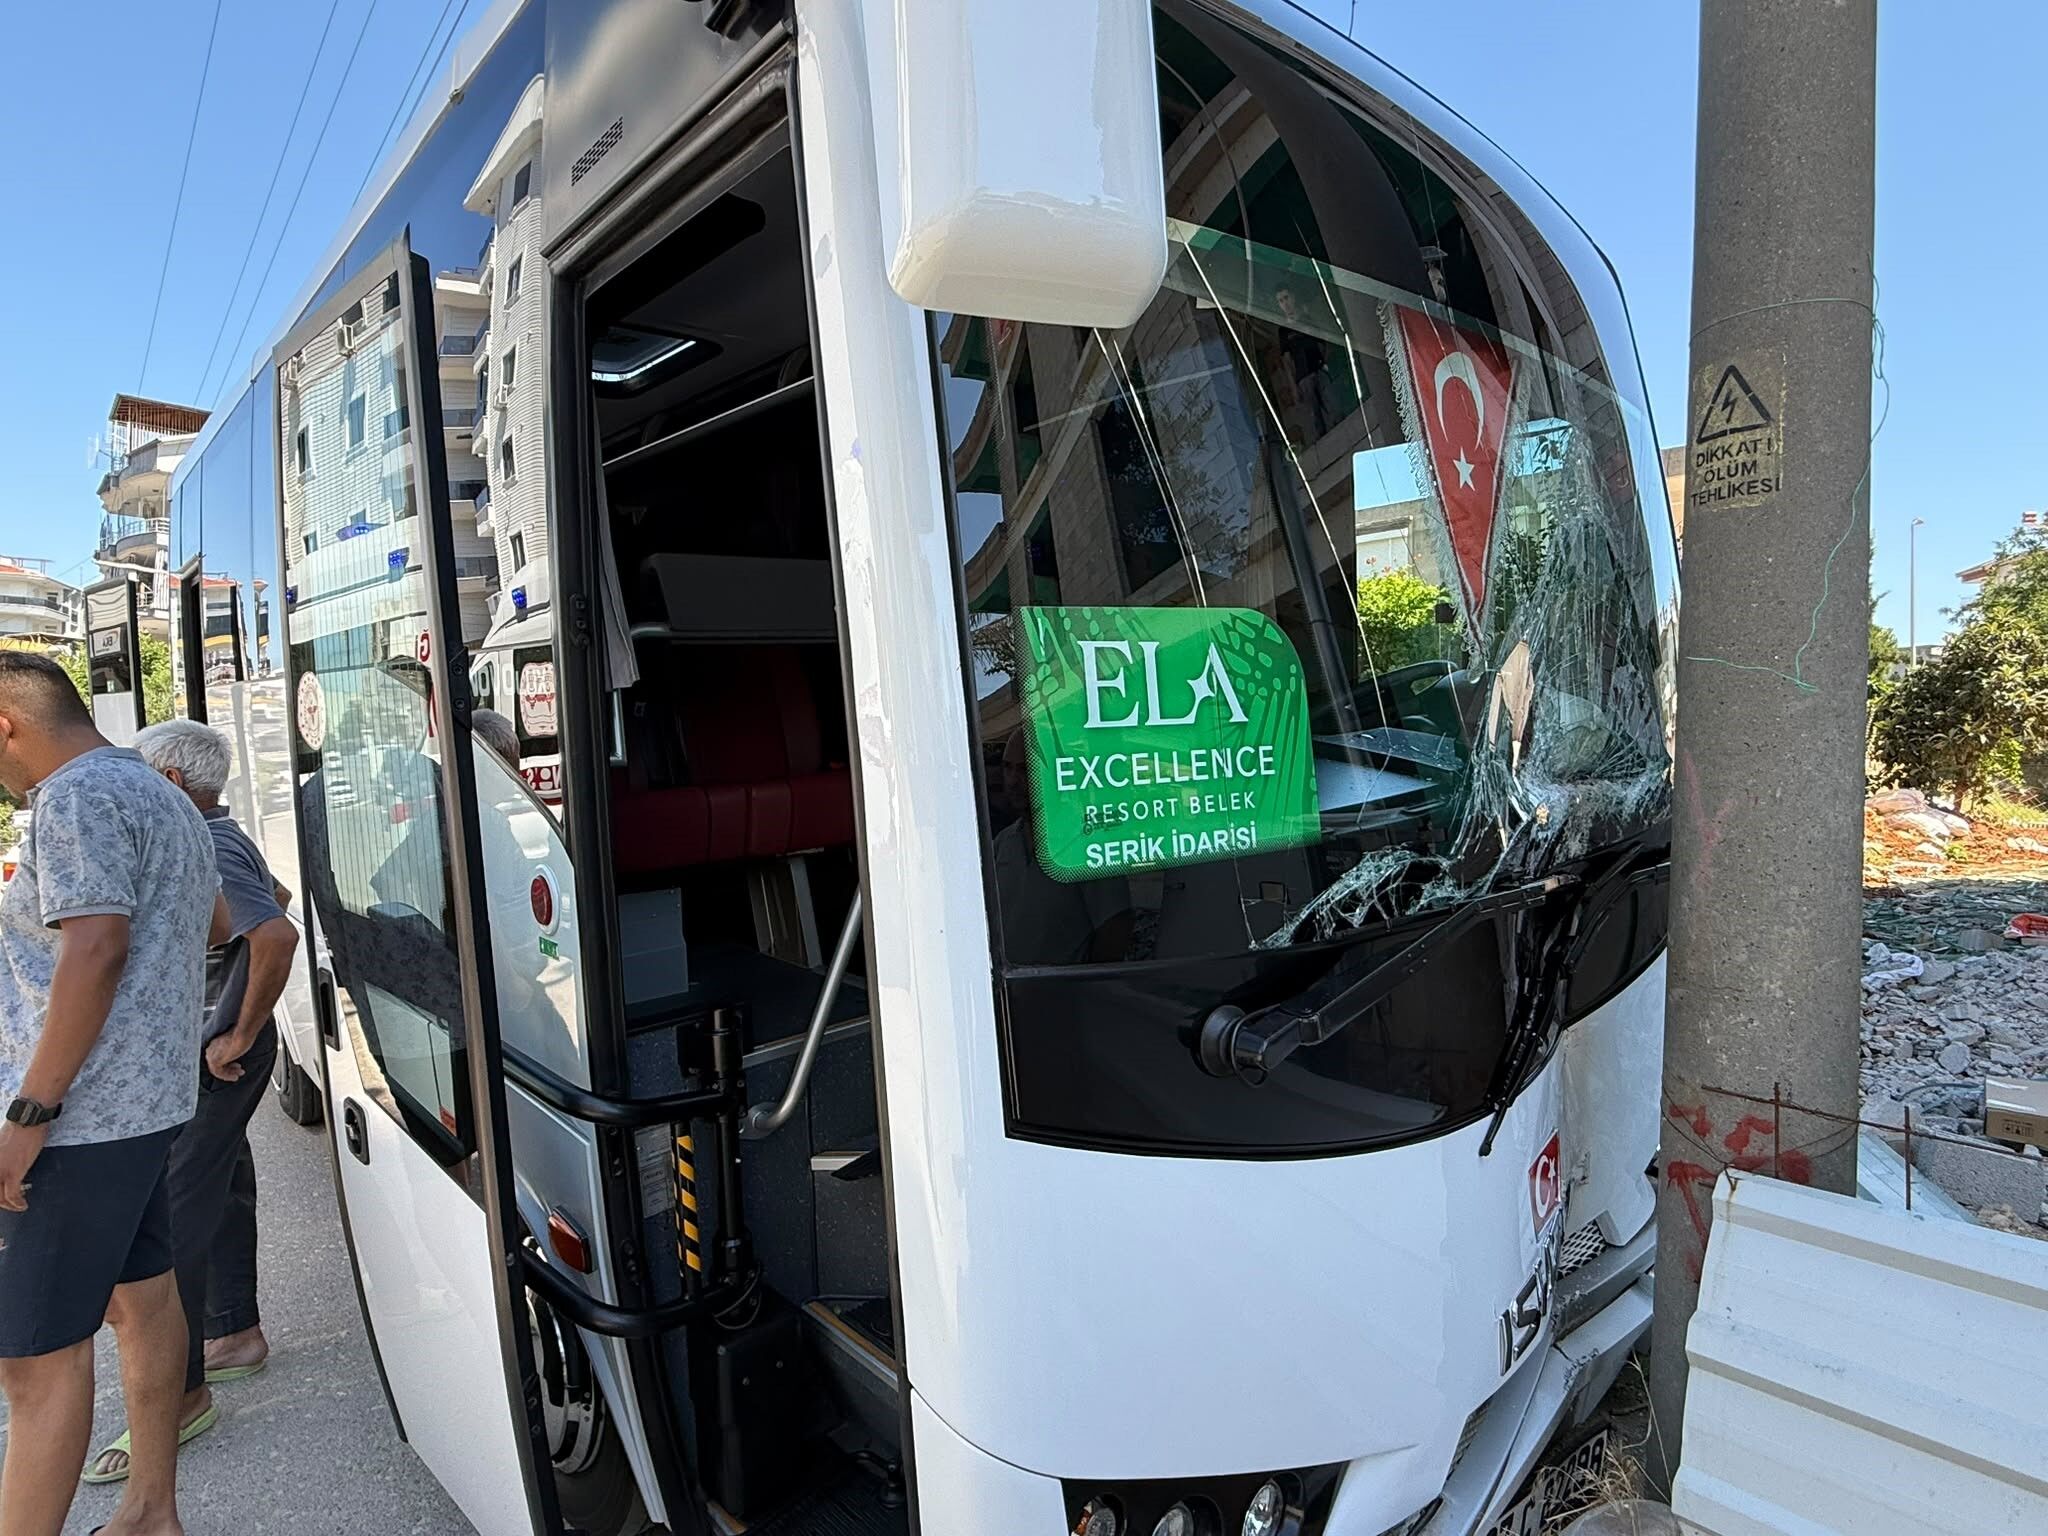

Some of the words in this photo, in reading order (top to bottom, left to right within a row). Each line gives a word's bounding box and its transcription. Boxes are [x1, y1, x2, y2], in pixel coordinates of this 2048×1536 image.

[1704, 460, 1757, 484] ÖLÜM
[1077, 640, 1249, 729] ELA
[1055, 745, 1276, 792] EXCELLENCE
[1086, 798, 1178, 824] RESORT
[1190, 791, 1256, 815] BELEK
[1086, 832, 1165, 869] SERİK
[1171, 820, 1257, 860] İDARİSİ
